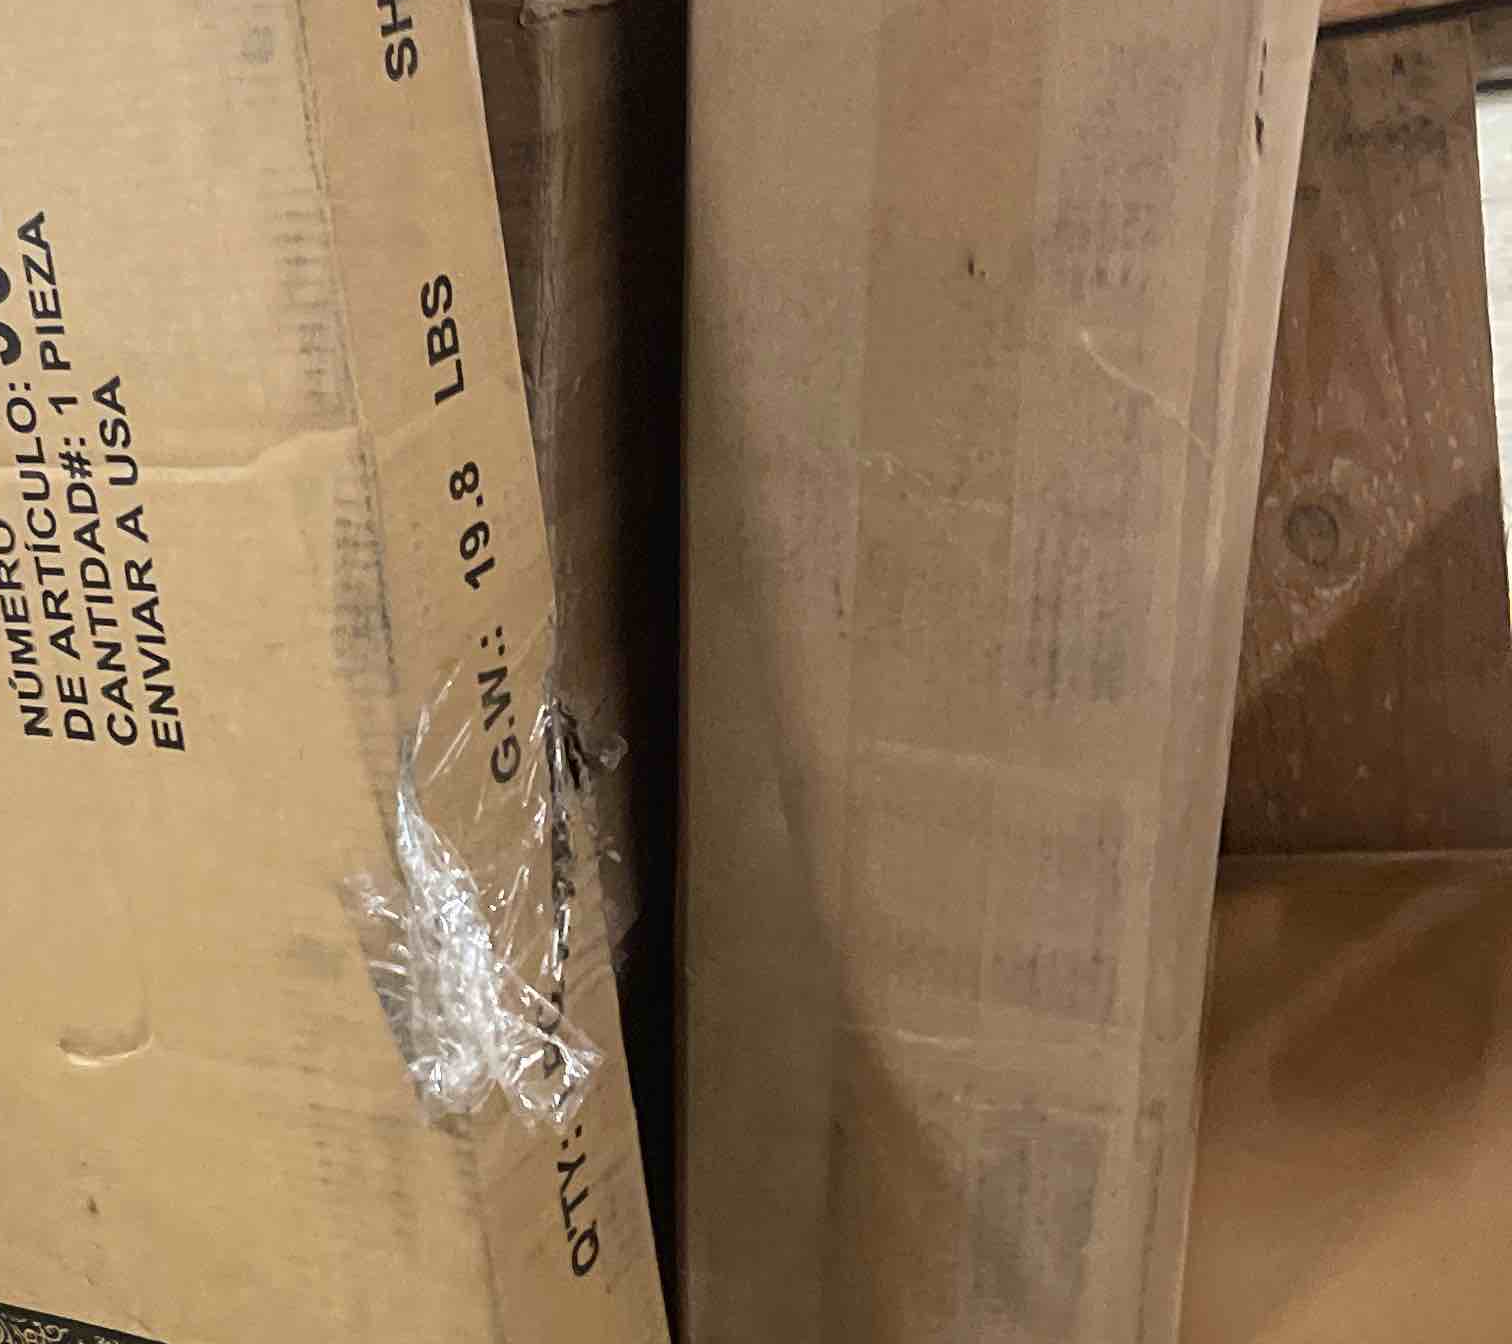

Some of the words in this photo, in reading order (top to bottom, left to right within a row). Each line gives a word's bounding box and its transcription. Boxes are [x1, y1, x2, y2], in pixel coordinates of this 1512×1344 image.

[17, 210, 74, 372] PIEZA
[421, 272, 466, 406] LBS
[54, 394, 80, 415] 1
[92, 375, 139, 489] USA
[6, 379, 80, 656] ARTÍCULO:
[115, 504, 150, 543] A
[63, 434, 139, 746] CANTIDAD#:
[123, 556, 186, 753] ENVIAR
[56, 674, 95, 742] DE
[556, 1124, 600, 1278] Q'TY:
